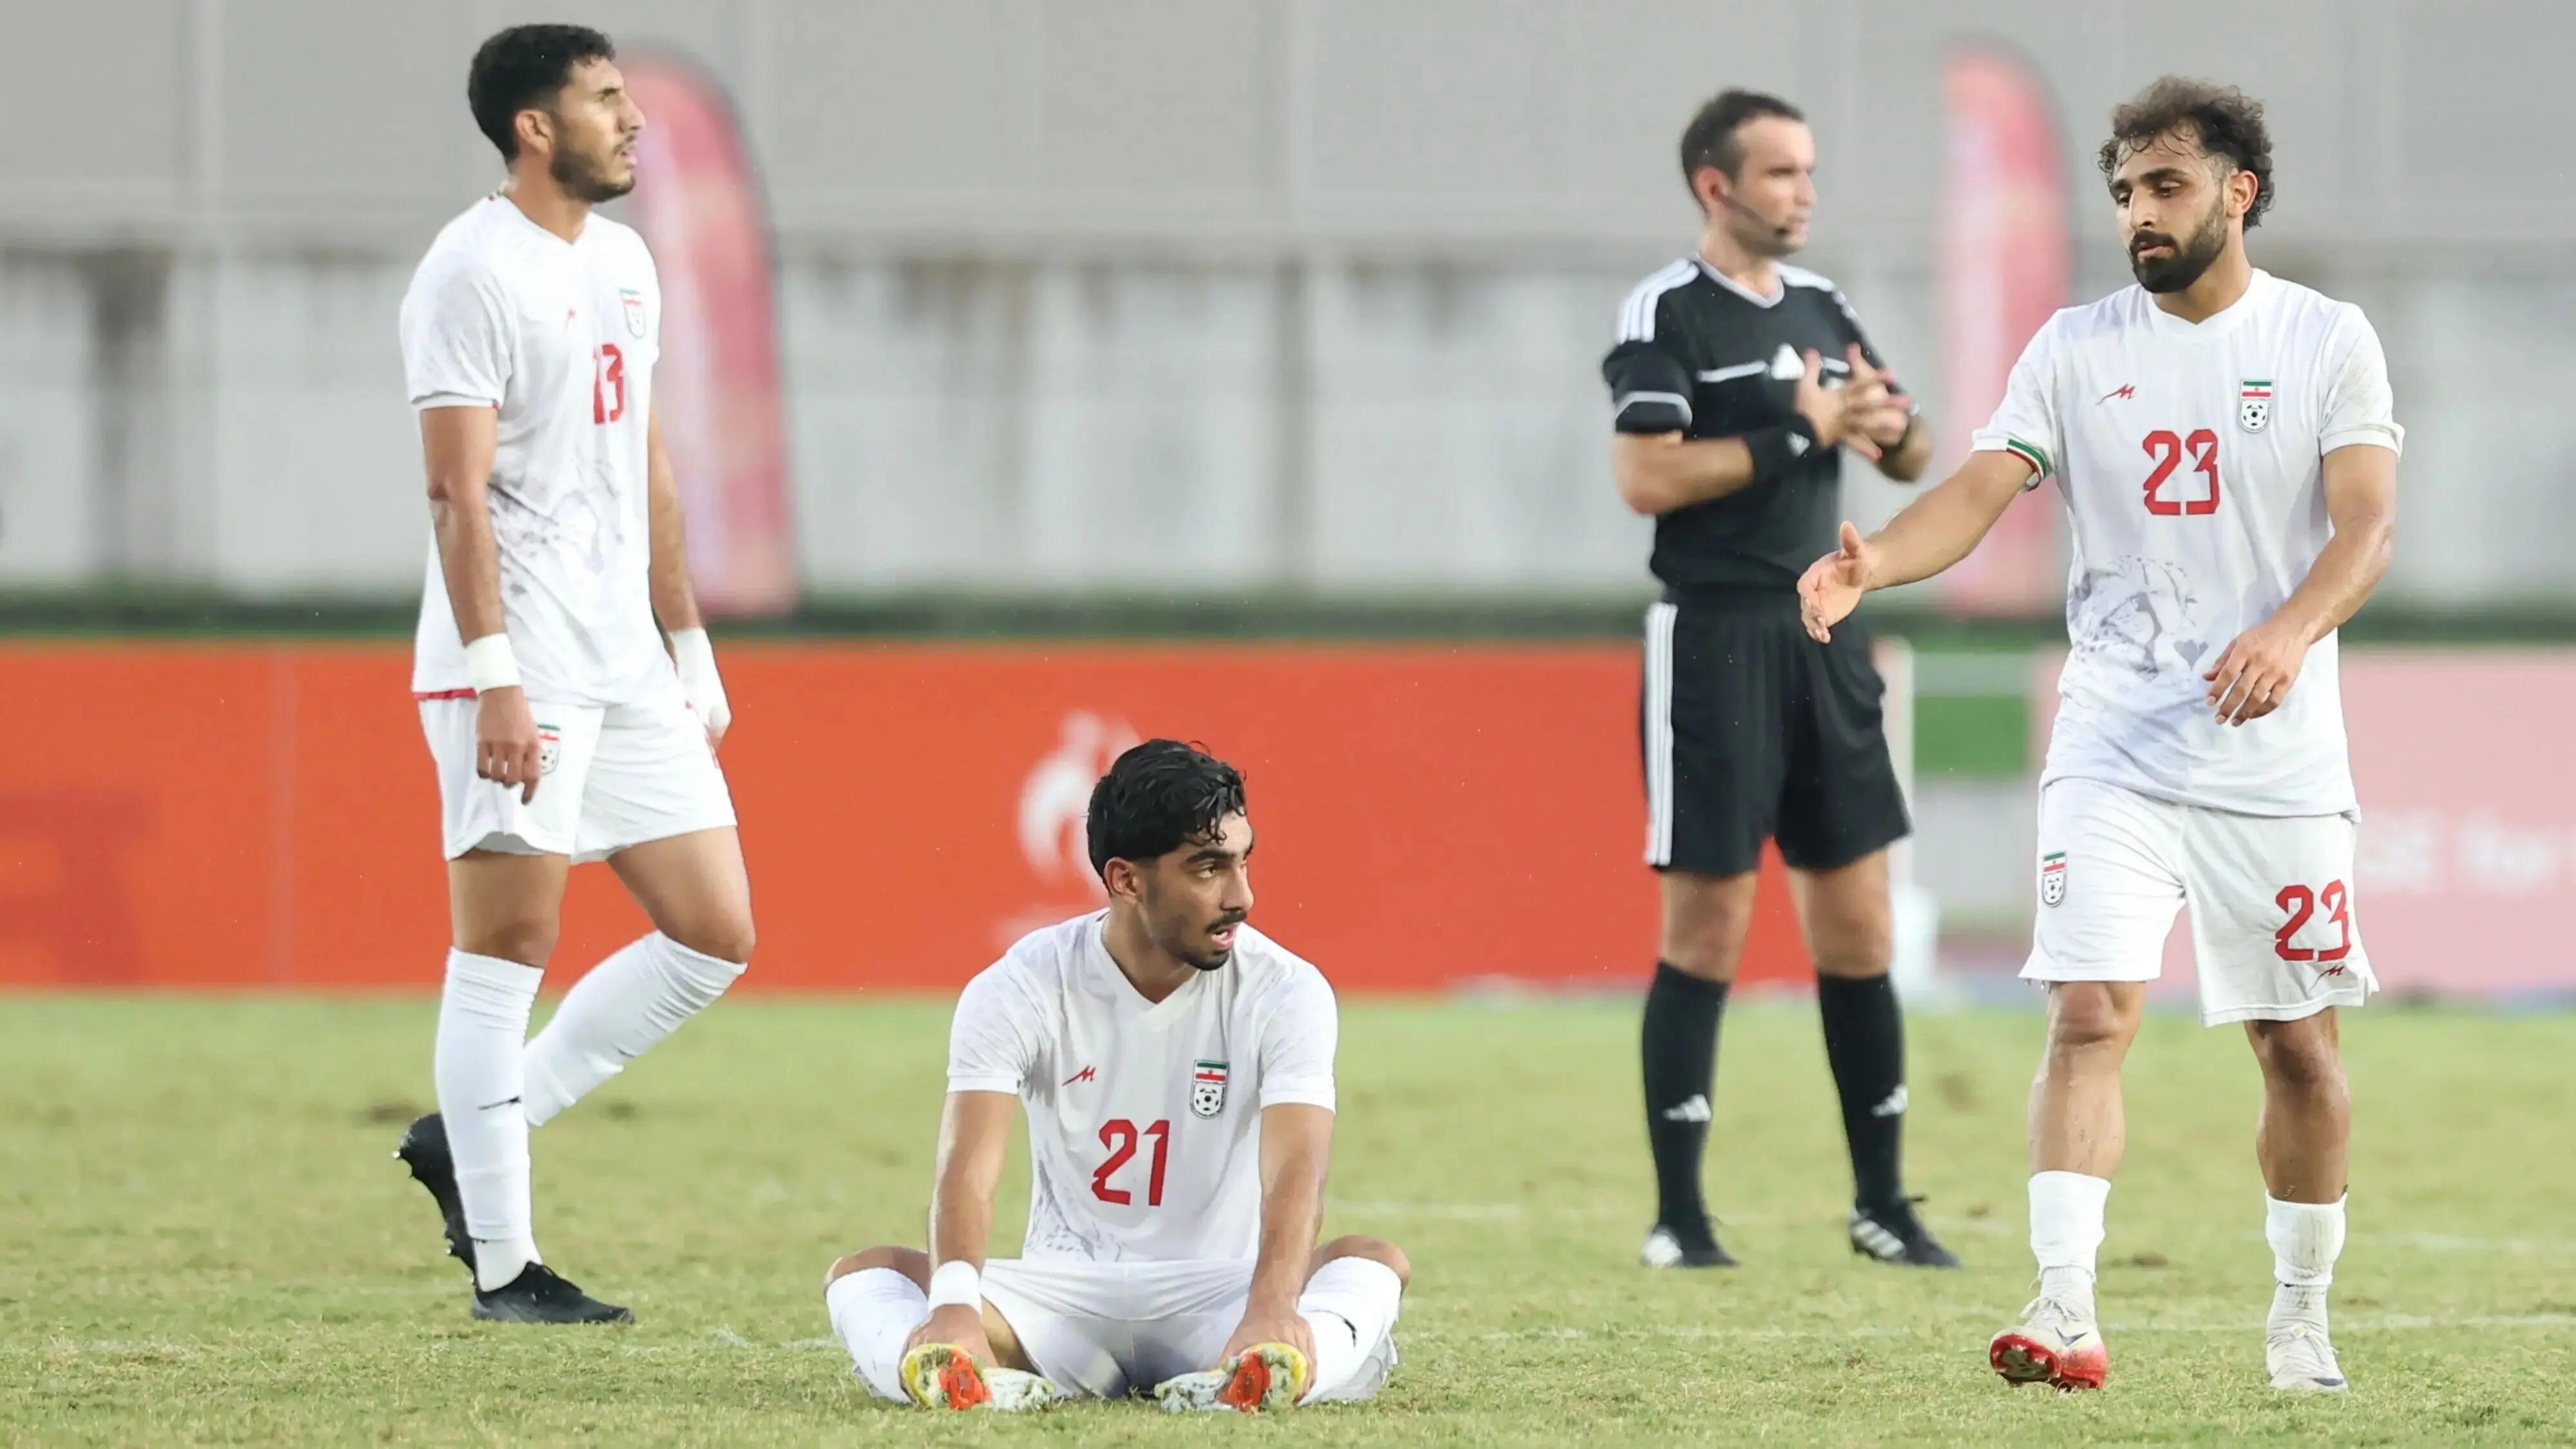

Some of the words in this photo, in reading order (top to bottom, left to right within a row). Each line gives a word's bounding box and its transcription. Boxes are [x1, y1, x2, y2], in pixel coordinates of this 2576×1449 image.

[593, 342, 625, 426] 13
[2143, 429, 2221, 516] 23
[2275, 879, 2352, 962] 23
[1092, 1119, 1170, 1206] 21
